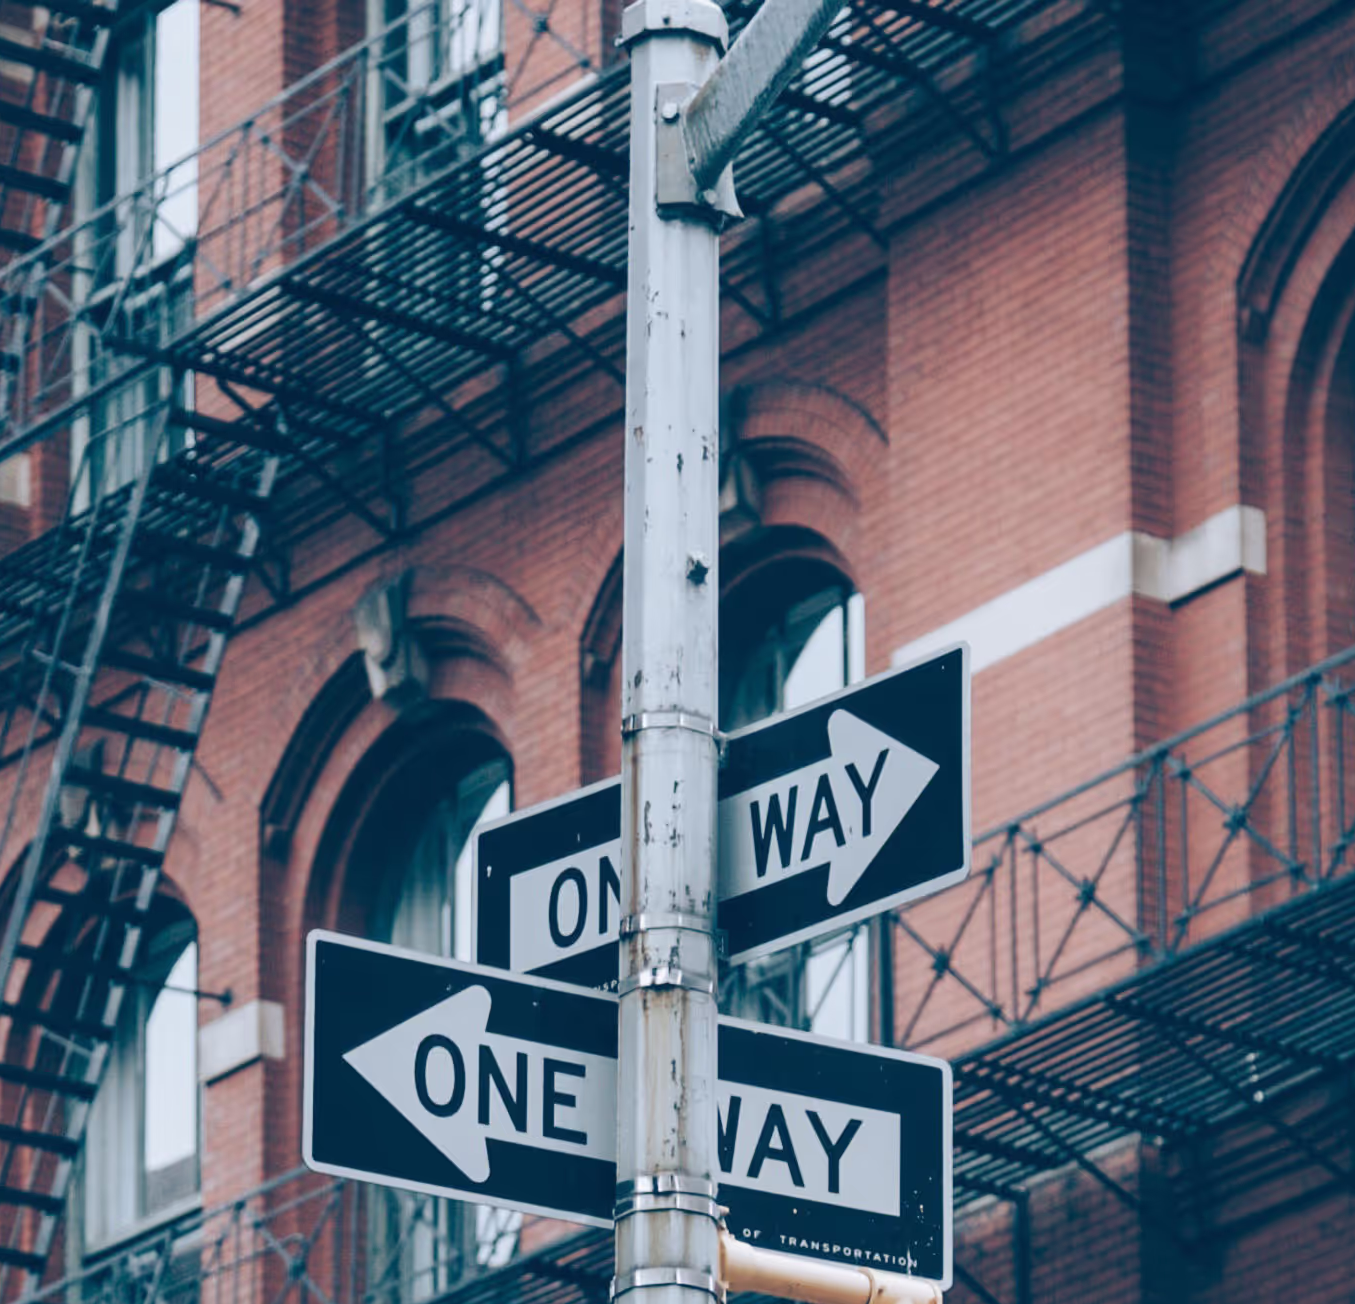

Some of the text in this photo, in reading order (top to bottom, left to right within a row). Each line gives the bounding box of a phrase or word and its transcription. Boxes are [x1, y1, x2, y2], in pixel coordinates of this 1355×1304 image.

[548, 748, 890, 949] ON WAY
[413, 1033, 588, 1145] ONE
[743, 1228, 918, 1269] OF TRANSPORTATION
